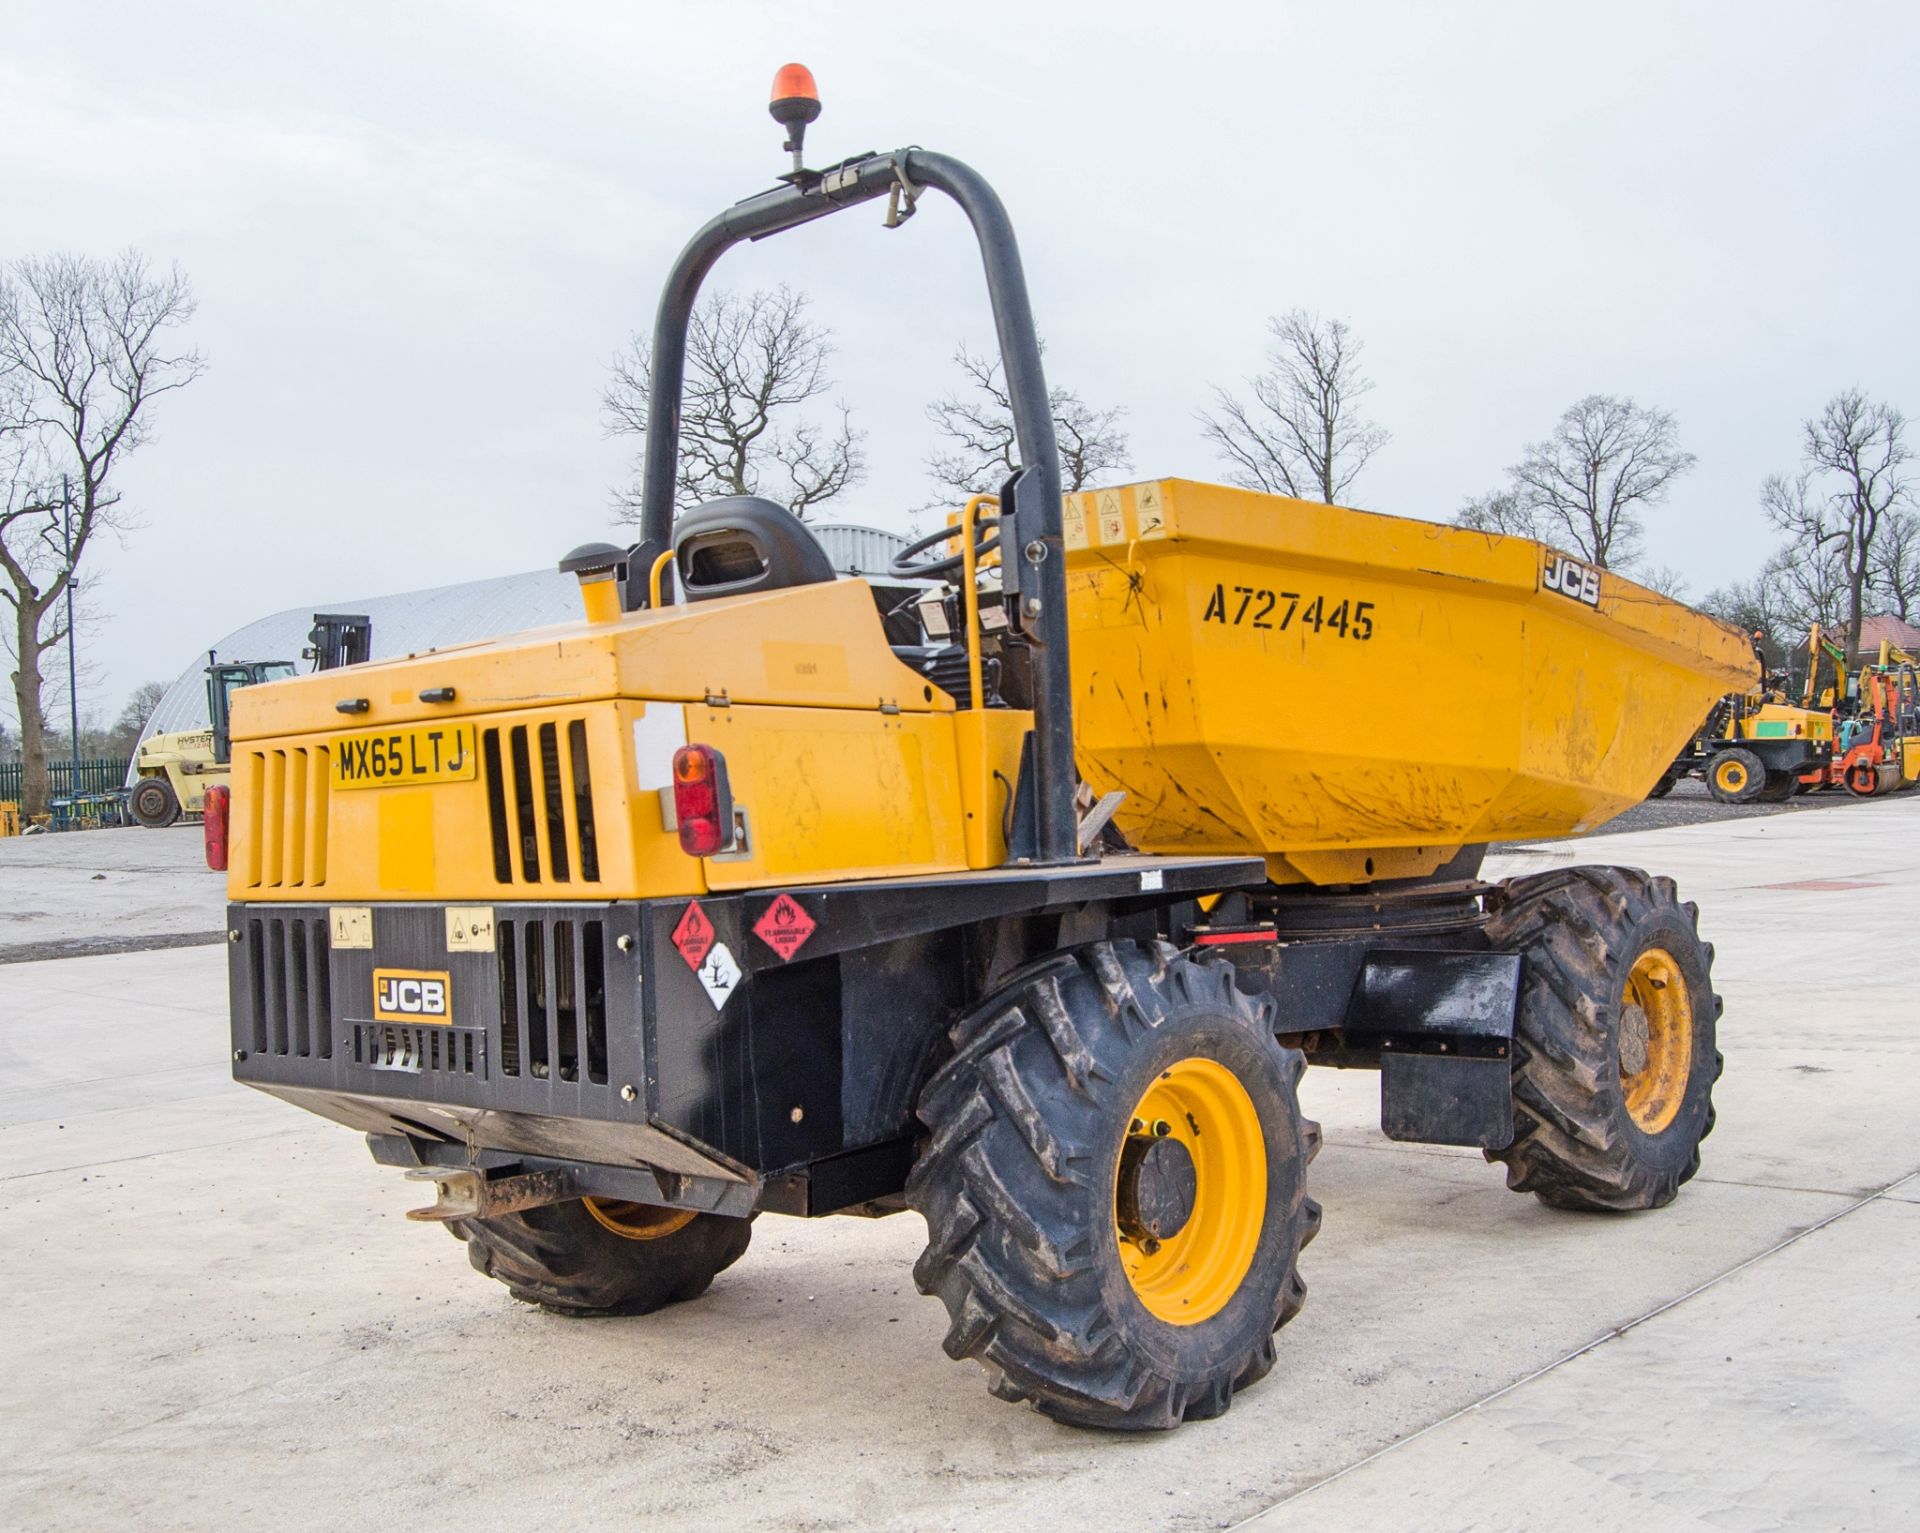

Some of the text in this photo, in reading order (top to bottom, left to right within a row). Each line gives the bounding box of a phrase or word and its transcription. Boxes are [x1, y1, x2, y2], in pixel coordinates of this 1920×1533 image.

[1545, 556, 1600, 605] JCB
[1203, 583, 1375, 641] A727445
[177, 734, 212, 745] HYSTER
[339, 729, 463, 780] MX65 LTJ
[379, 979, 445, 1013] JCB
